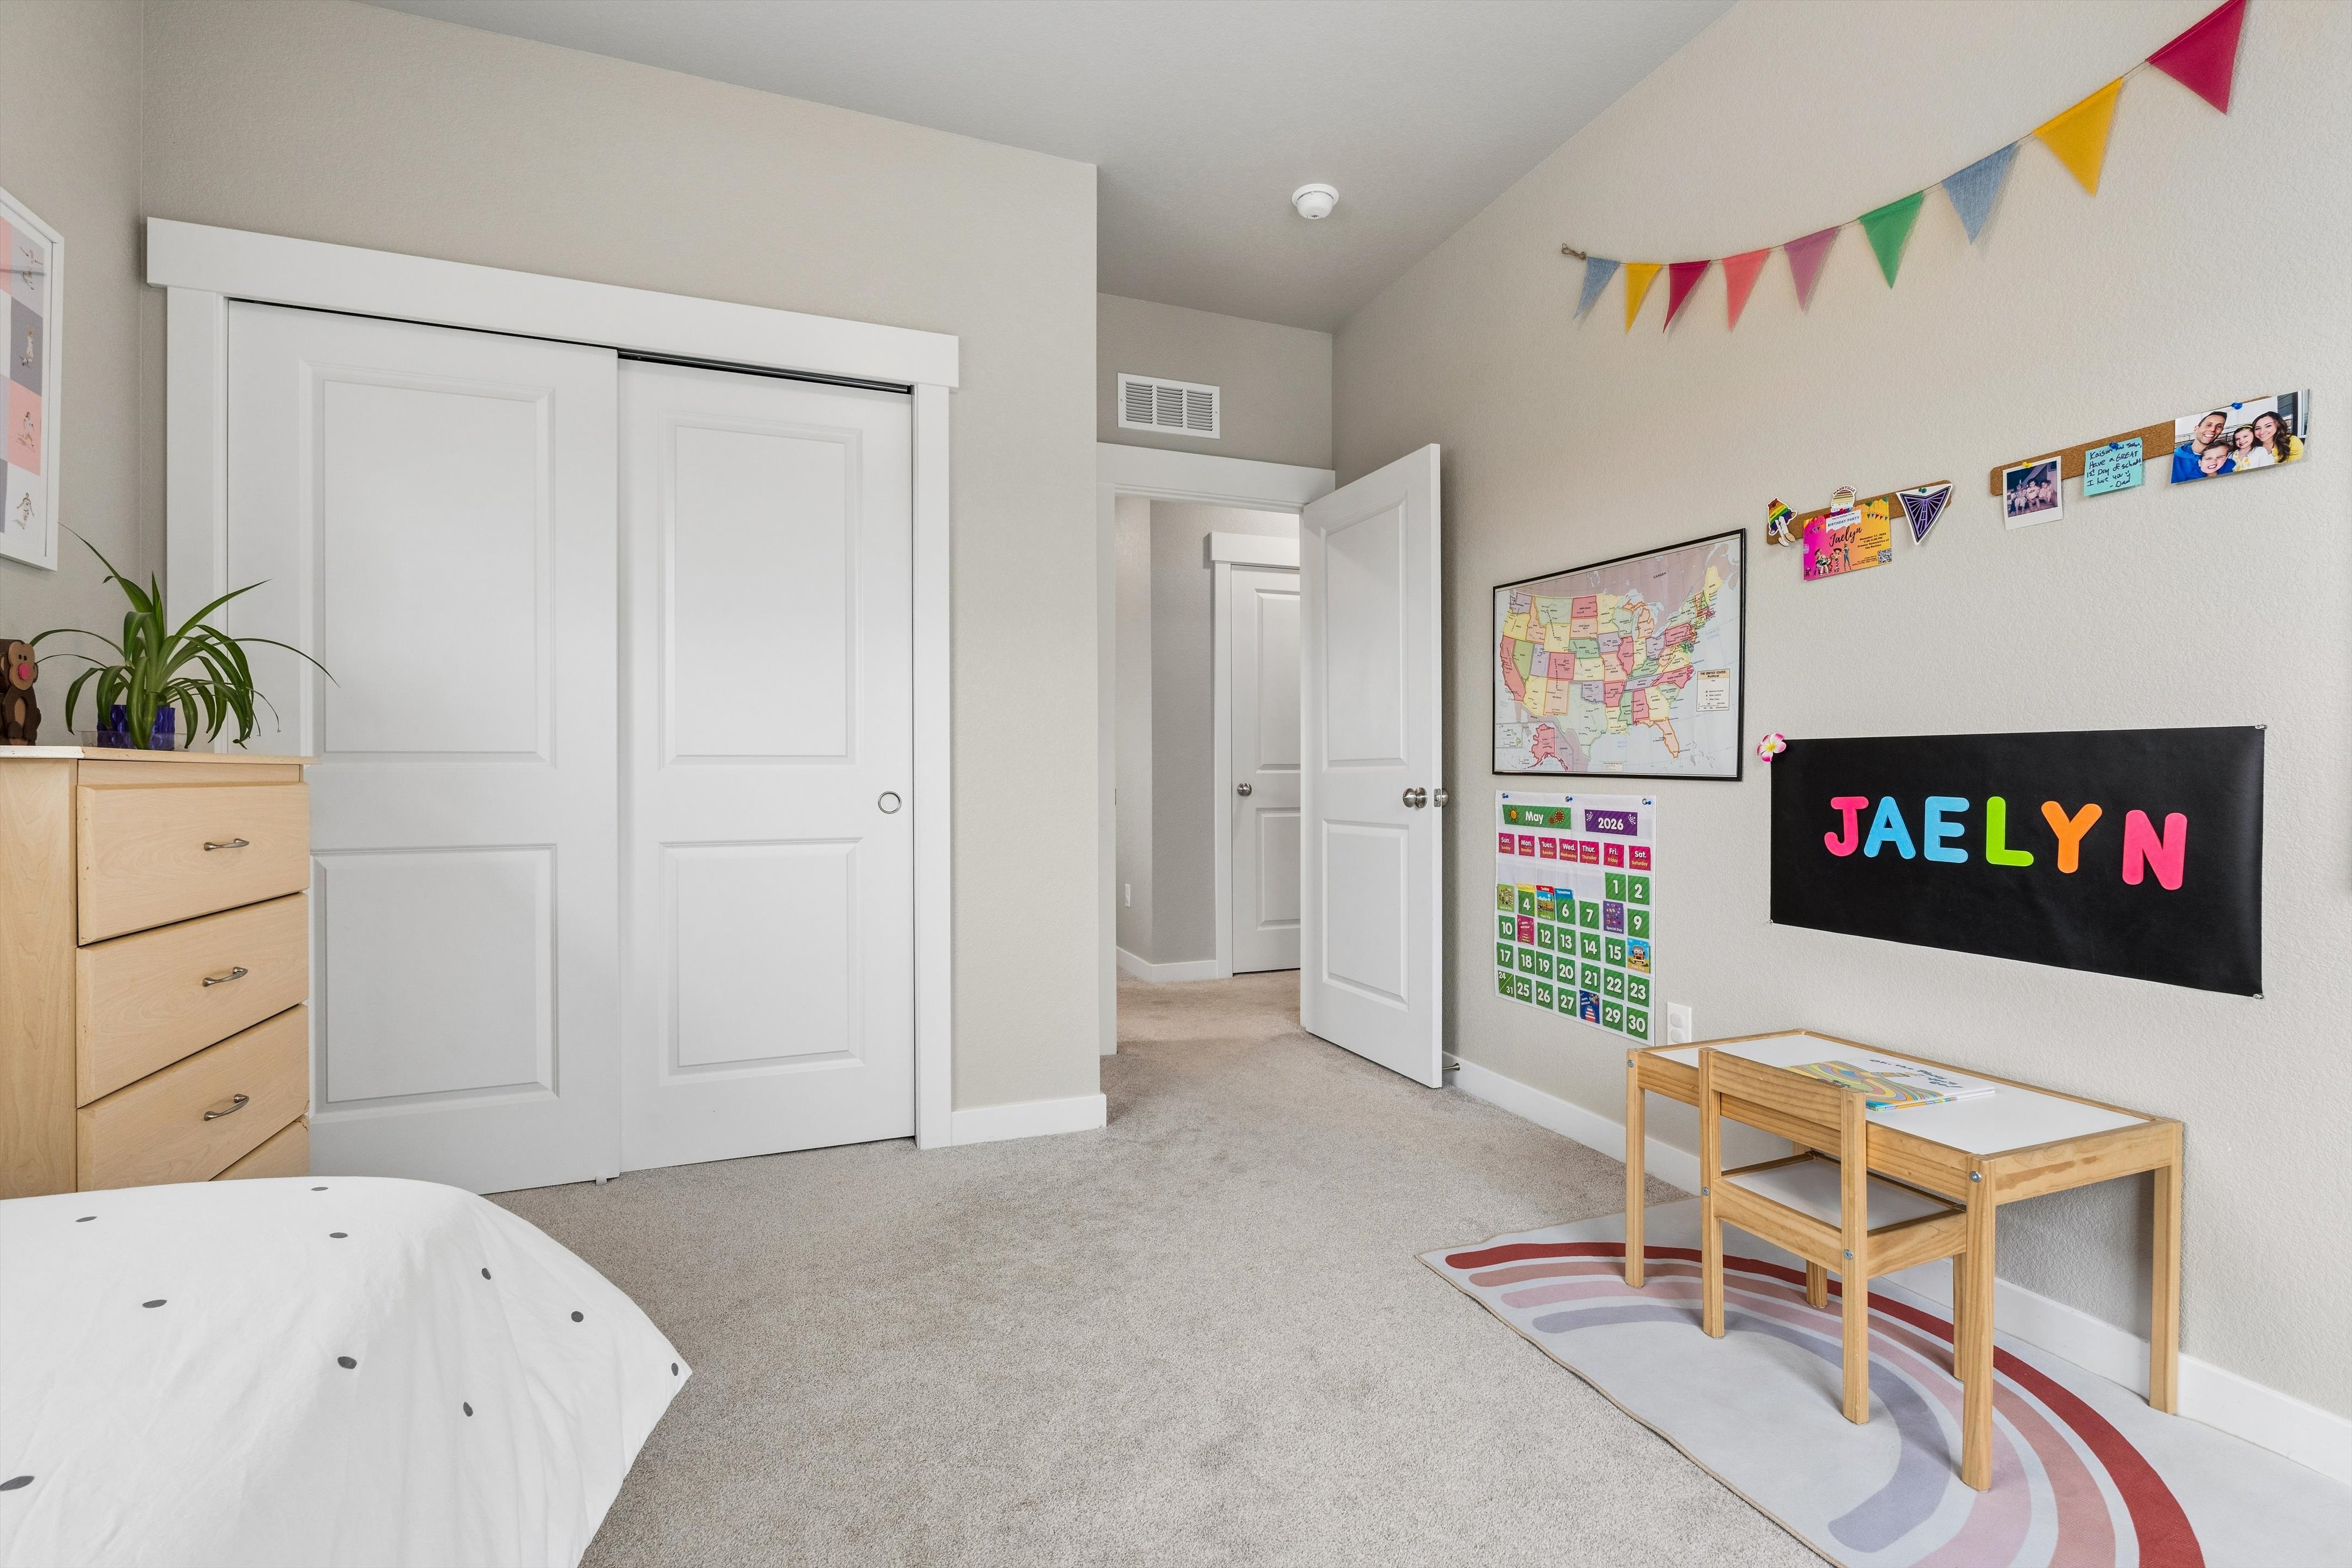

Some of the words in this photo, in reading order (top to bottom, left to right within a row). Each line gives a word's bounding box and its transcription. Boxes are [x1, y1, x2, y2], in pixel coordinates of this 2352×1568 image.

[2089, 460, 2105, 469] Have
[2116, 451, 2138, 462] GREAT
[2116, 476, 2130, 487] Dad
[1833, 486, 1856, 494] NASHVILLE
[1829, 526, 1862, 547] Jaelyn
[1526, 811, 1544, 824] May
[1598, 818, 1623, 830] 2026
[1824, 796, 2188, 890] JAELYN
[1613, 880, 1618, 894] 1
[1635, 884, 1642, 898] 2
[1523, 898, 1530, 911] 4
[1562, 904, 1569, 917] 6
[1586, 909, 1593, 922] 7
[1633, 915, 1642, 930] 9
[1502, 921, 1512, 935] 10
[1541, 930, 1551, 944] 12
[1561, 934, 1572, 949] 13
[1584, 940, 1597, 954] 14
[1609, 944, 1622, 960] 15
[1501, 949, 1511, 962] 17
[1521, 954, 1532, 968] 18
[1539, 958, 1549, 972] 19
[1559, 964, 1573, 979] 20
[1585, 971, 1597, 987] 21
[1606, 977, 1622, 993] 22
[1506, 986, 1513, 994] 31
[1518, 982, 1529, 997] 25
[1538, 988, 1551, 1003] 26
[1631, 982, 1646, 999] 23
[1561, 995, 1574, 1009] 27
[1605, 1007, 1621, 1023] 29
[1628, 1015, 1645, 1032] 30
